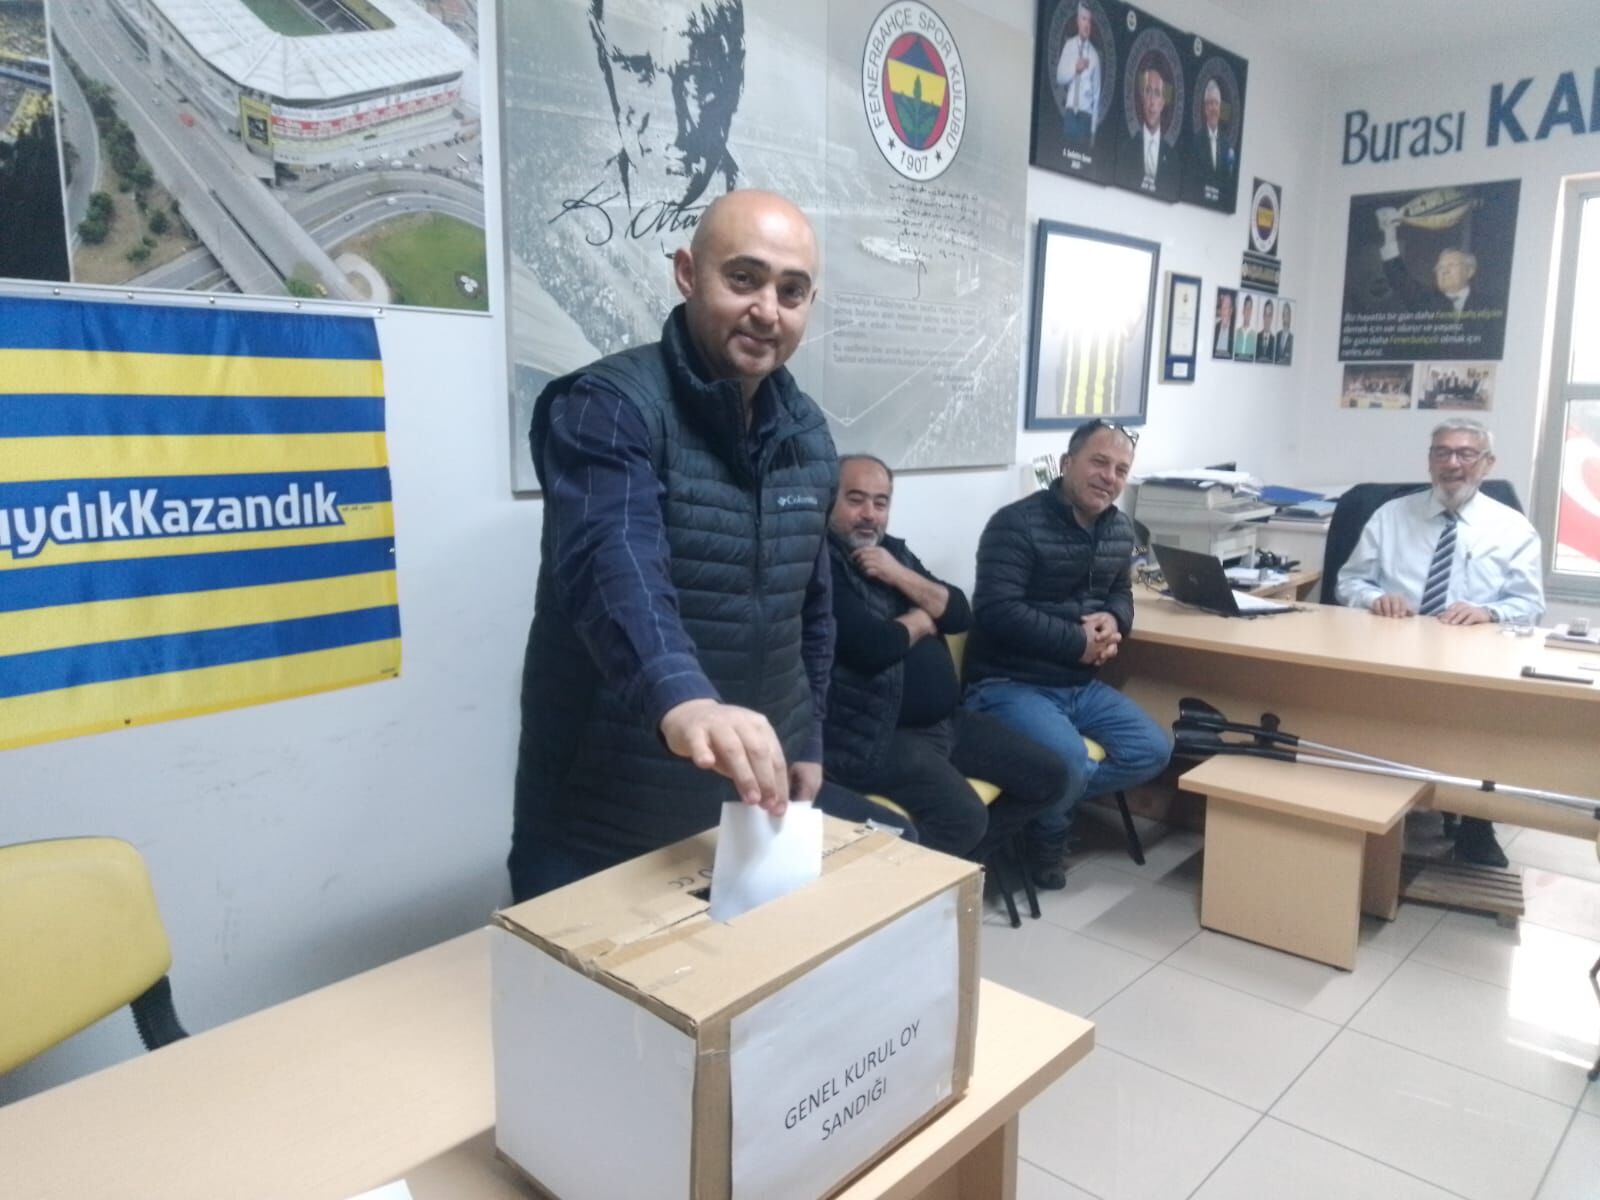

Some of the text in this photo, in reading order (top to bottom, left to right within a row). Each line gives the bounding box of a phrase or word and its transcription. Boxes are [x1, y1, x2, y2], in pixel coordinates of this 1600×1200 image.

[867, 8, 913, 130] FENERBAHÇE
[918, 12, 952, 58] SPOR
[900, 150, 929, 174] 1907
[1342, 109, 1466, 165] Burası
[784, 1018, 920, 1130] GENEL KURUL OY
[821, 1076, 887, 1141] SANDIĞI
